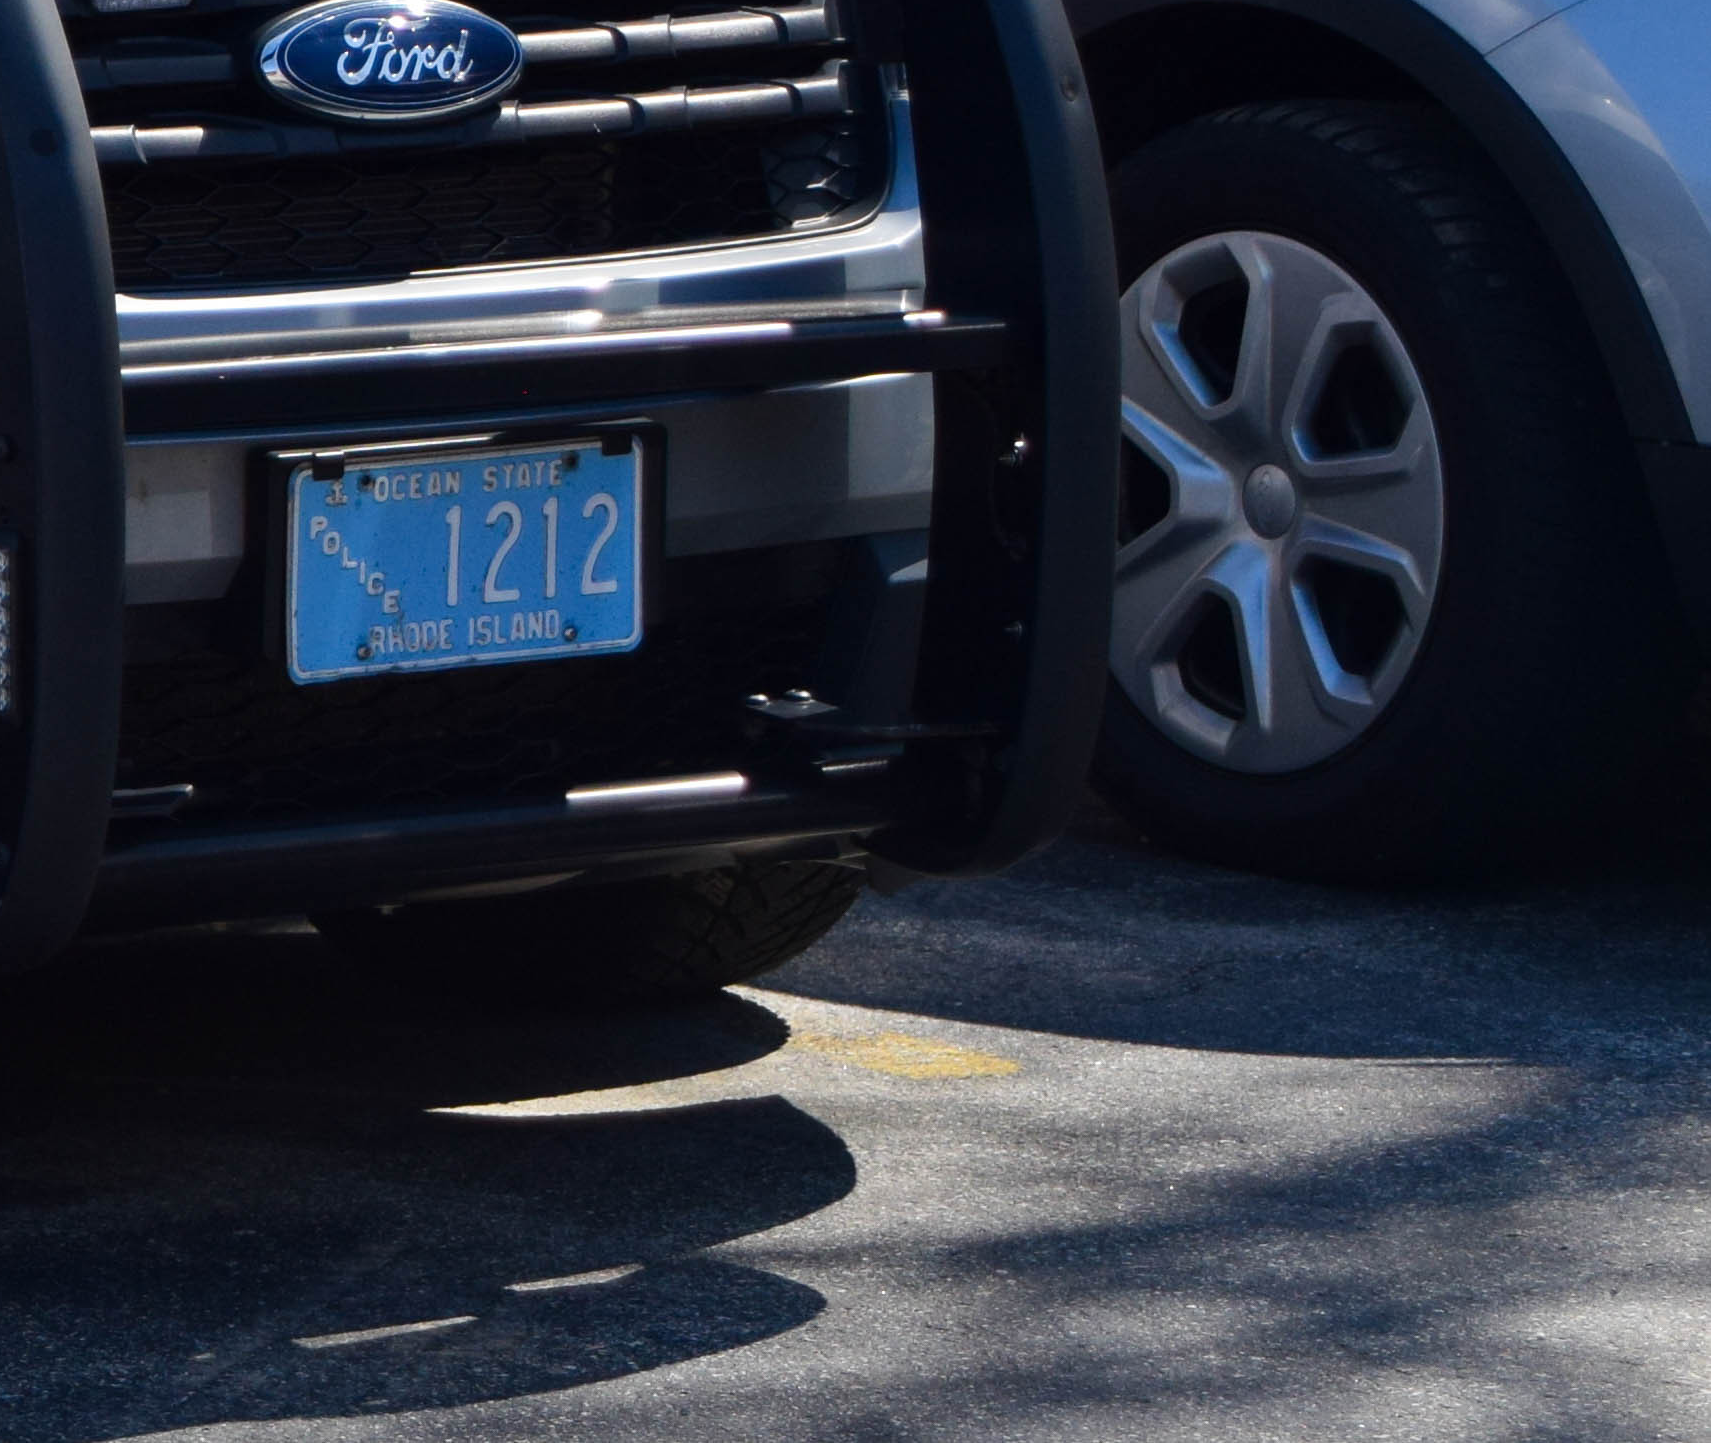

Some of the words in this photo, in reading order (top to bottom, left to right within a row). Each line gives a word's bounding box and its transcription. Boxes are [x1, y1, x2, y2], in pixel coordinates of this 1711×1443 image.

[337, 18, 474, 85] Ford
[374, 471, 461, 502] OCEAN
[483, 459, 563, 493] STATE
[310, 515, 401, 614] POLICE
[445, 492, 620, 607] 1212
[369, 618, 454, 654] RHODE
[468, 608, 561, 645] ISLAND
